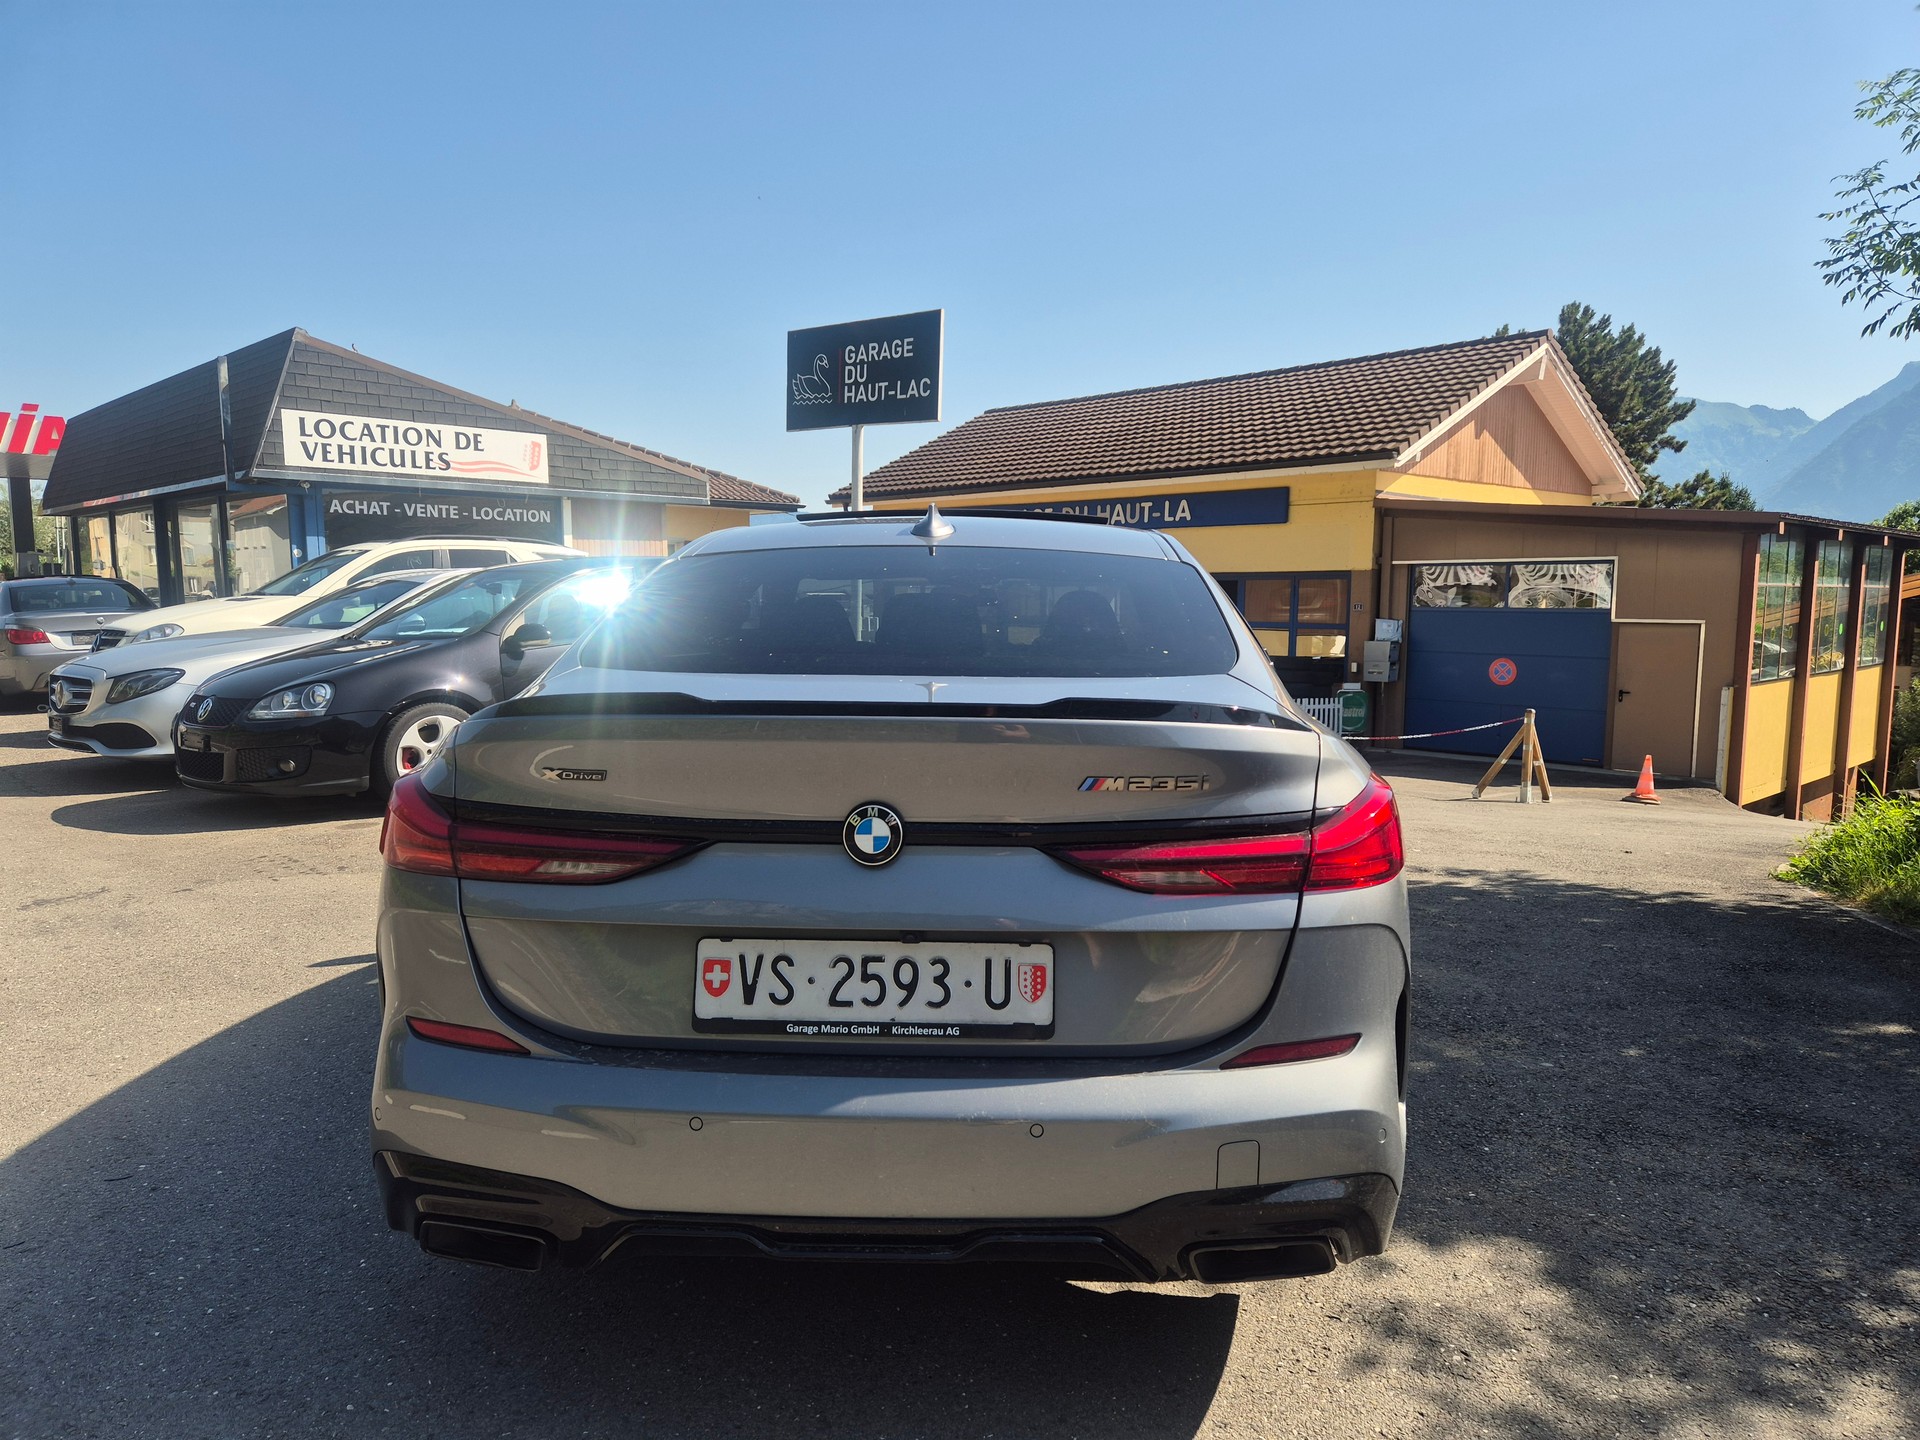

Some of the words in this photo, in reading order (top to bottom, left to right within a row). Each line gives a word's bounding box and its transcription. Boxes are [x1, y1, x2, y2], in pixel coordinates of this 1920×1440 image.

[845, 337, 914, 364] GARAGE
[844, 364, 868, 383] DU
[844, 378, 931, 403] HAUT-LAC
[298, 416, 442, 449] LOCATION
[454, 431, 485, 452] DE
[300, 441, 451, 471] VEHICULES
[329, 499, 390, 516] ACHAT
[404, 503, 459, 519] VENTE
[472, 506, 551, 523] LOCATION
[849, 807, 897, 826] BMW
[828, 955, 952, 1009] 2593
[786, 1023, 818, 1035] Garage
[820, 1024, 849, 1034] Mario
[850, 1025, 880, 1034] GmbH
[891, 1025, 944, 1036] Kirchleerau
[945, 1026, 960, 1036] AG
